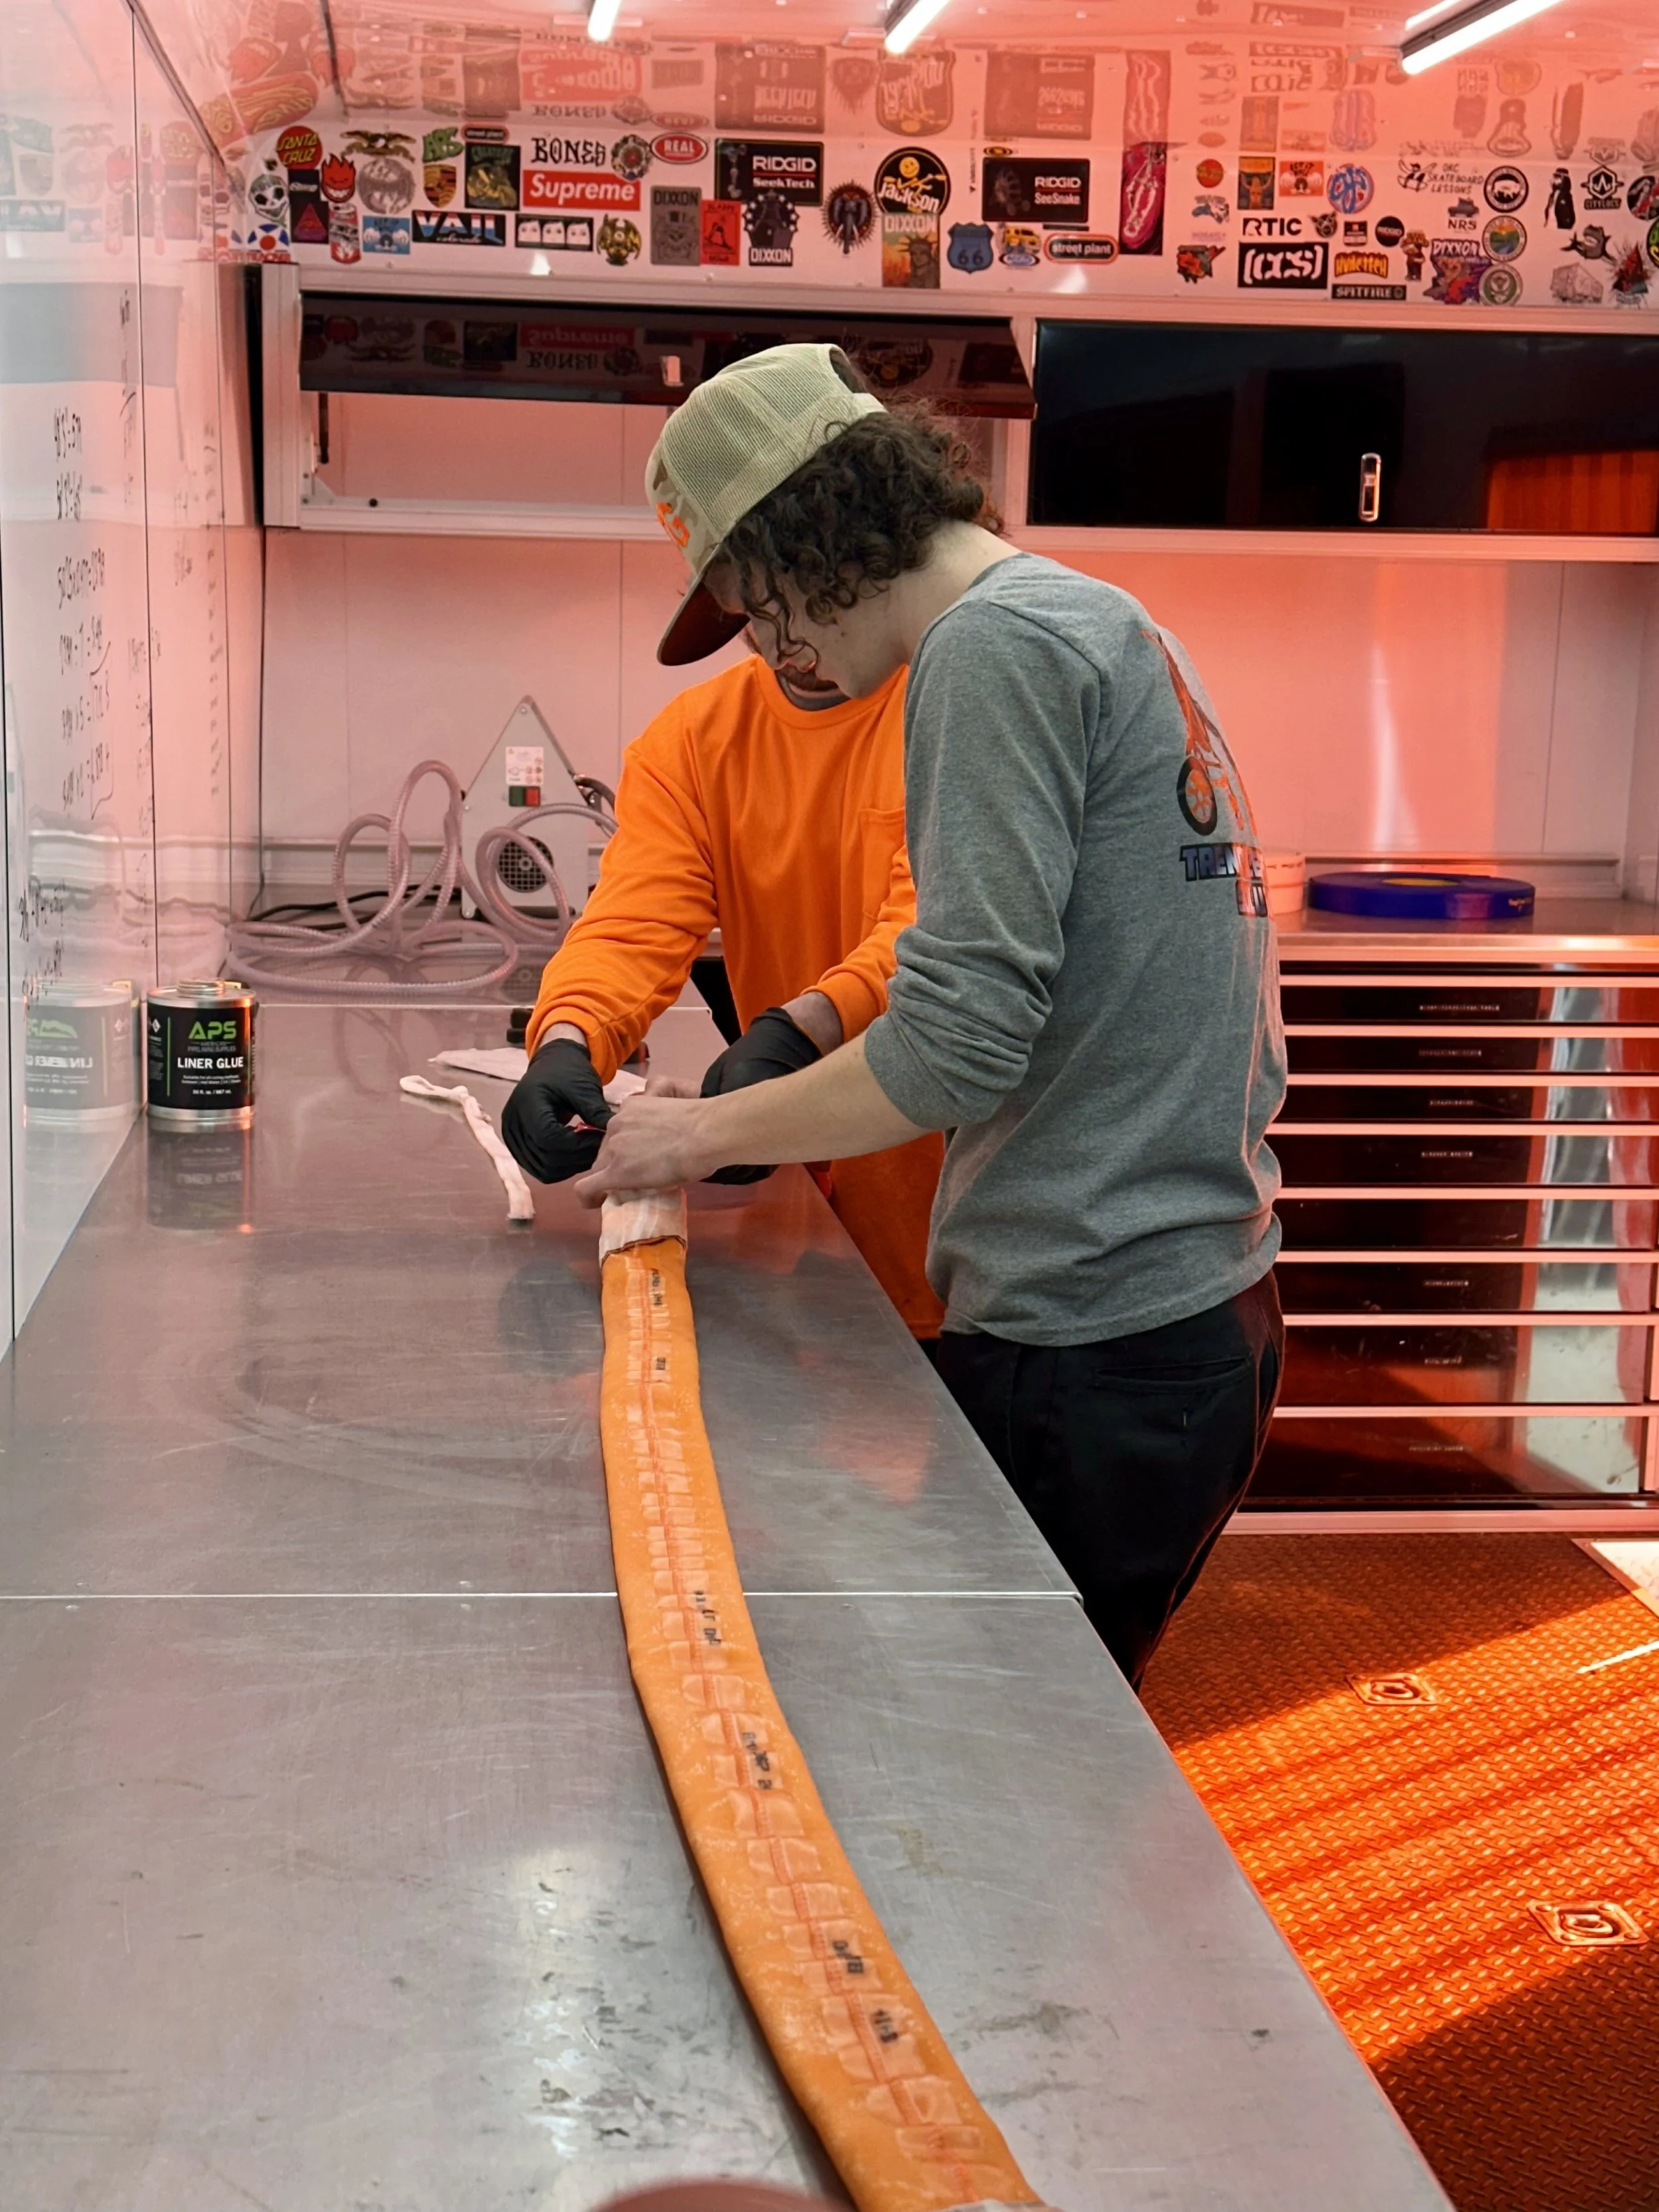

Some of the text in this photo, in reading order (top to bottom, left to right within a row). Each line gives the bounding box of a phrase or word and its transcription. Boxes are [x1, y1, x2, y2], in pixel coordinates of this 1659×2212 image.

[277, 134, 317, 151] SANTA
[664, 139, 695, 153] REAL
[283, 149, 315, 165] CRUZ
[531, 137, 605, 167] BONES
[753, 155, 816, 172] RIDGID
[753, 177, 815, 189] SeekTech
[1035, 177, 1082, 188] RIDGID
[1427, 172, 1484, 185] SKATEBOARD
[531, 173, 635, 205] Supreme
[1431, 184, 1473, 194] LESSONS
[654, 190, 699, 206] DIXXON
[1035, 192, 1081, 206] SeeSnake
[415, 210, 504, 244] VAIL
[885, 215, 937, 234] DIXXON
[1243, 218, 1303, 236] RTIC
[1448, 219, 1477, 230] NRS
[751, 248, 792, 263] DIXXON
[1051, 242, 1112, 256] street plant
[1433, 240, 1479, 257] DIXXON
[1336, 286, 1392, 298] SPITFIRE
[188, 1020, 237, 1040] APS
[177, 1056, 244, 1069] LINER GLUE
